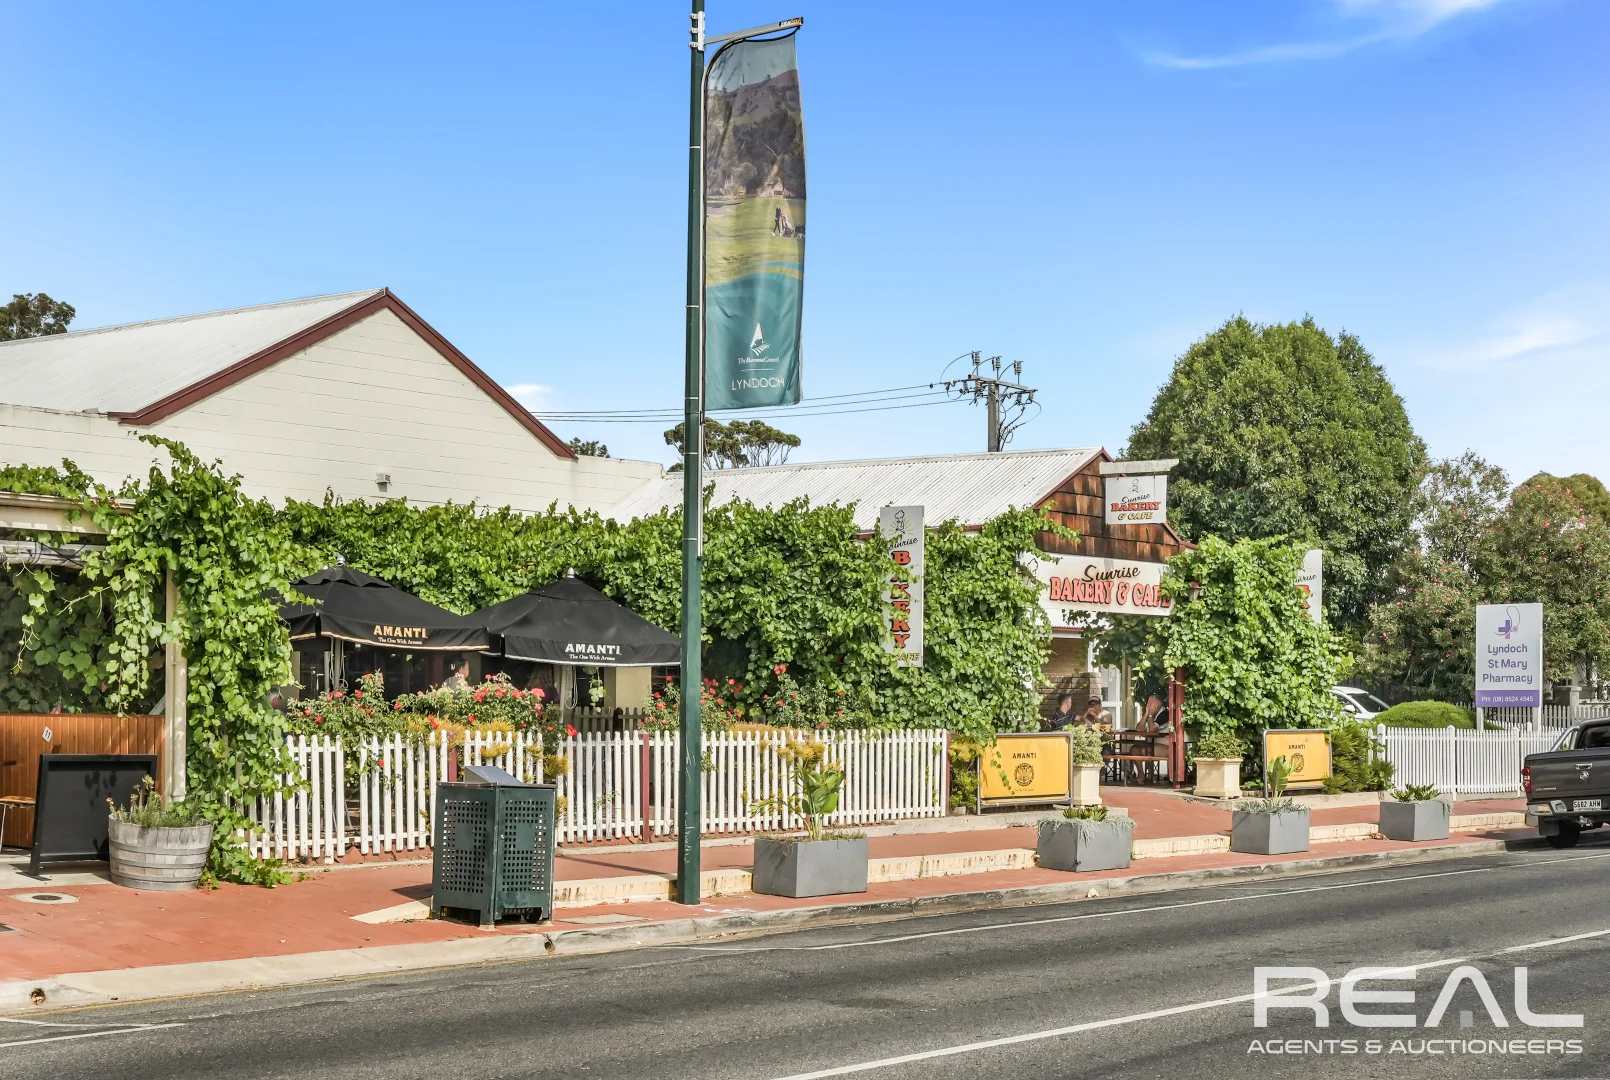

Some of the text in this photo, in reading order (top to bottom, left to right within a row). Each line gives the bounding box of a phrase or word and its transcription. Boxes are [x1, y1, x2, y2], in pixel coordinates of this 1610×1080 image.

[731, 376, 785, 391] LYNDOCH
[1121, 494, 1151, 504] Sunrise
[1111, 502, 1161, 512] BAKERY
[1128, 512, 1154, 521] CAFE
[887, 537, 919, 550] unrise
[1081, 564, 1141, 582] Sunrise
[1049, 576, 1115, 605] BAKERY
[1116, 581, 1130, 606] &
[374, 625, 428, 638] AMANTI
[564, 643, 622, 654] AMANTI
[1488, 644, 1527, 655] Lyndoch
[1488, 659, 1528, 670] St Mary
[1482, 673, 1533, 685] Pharmacy
[1012, 752, 1037, 760] AMANTI
